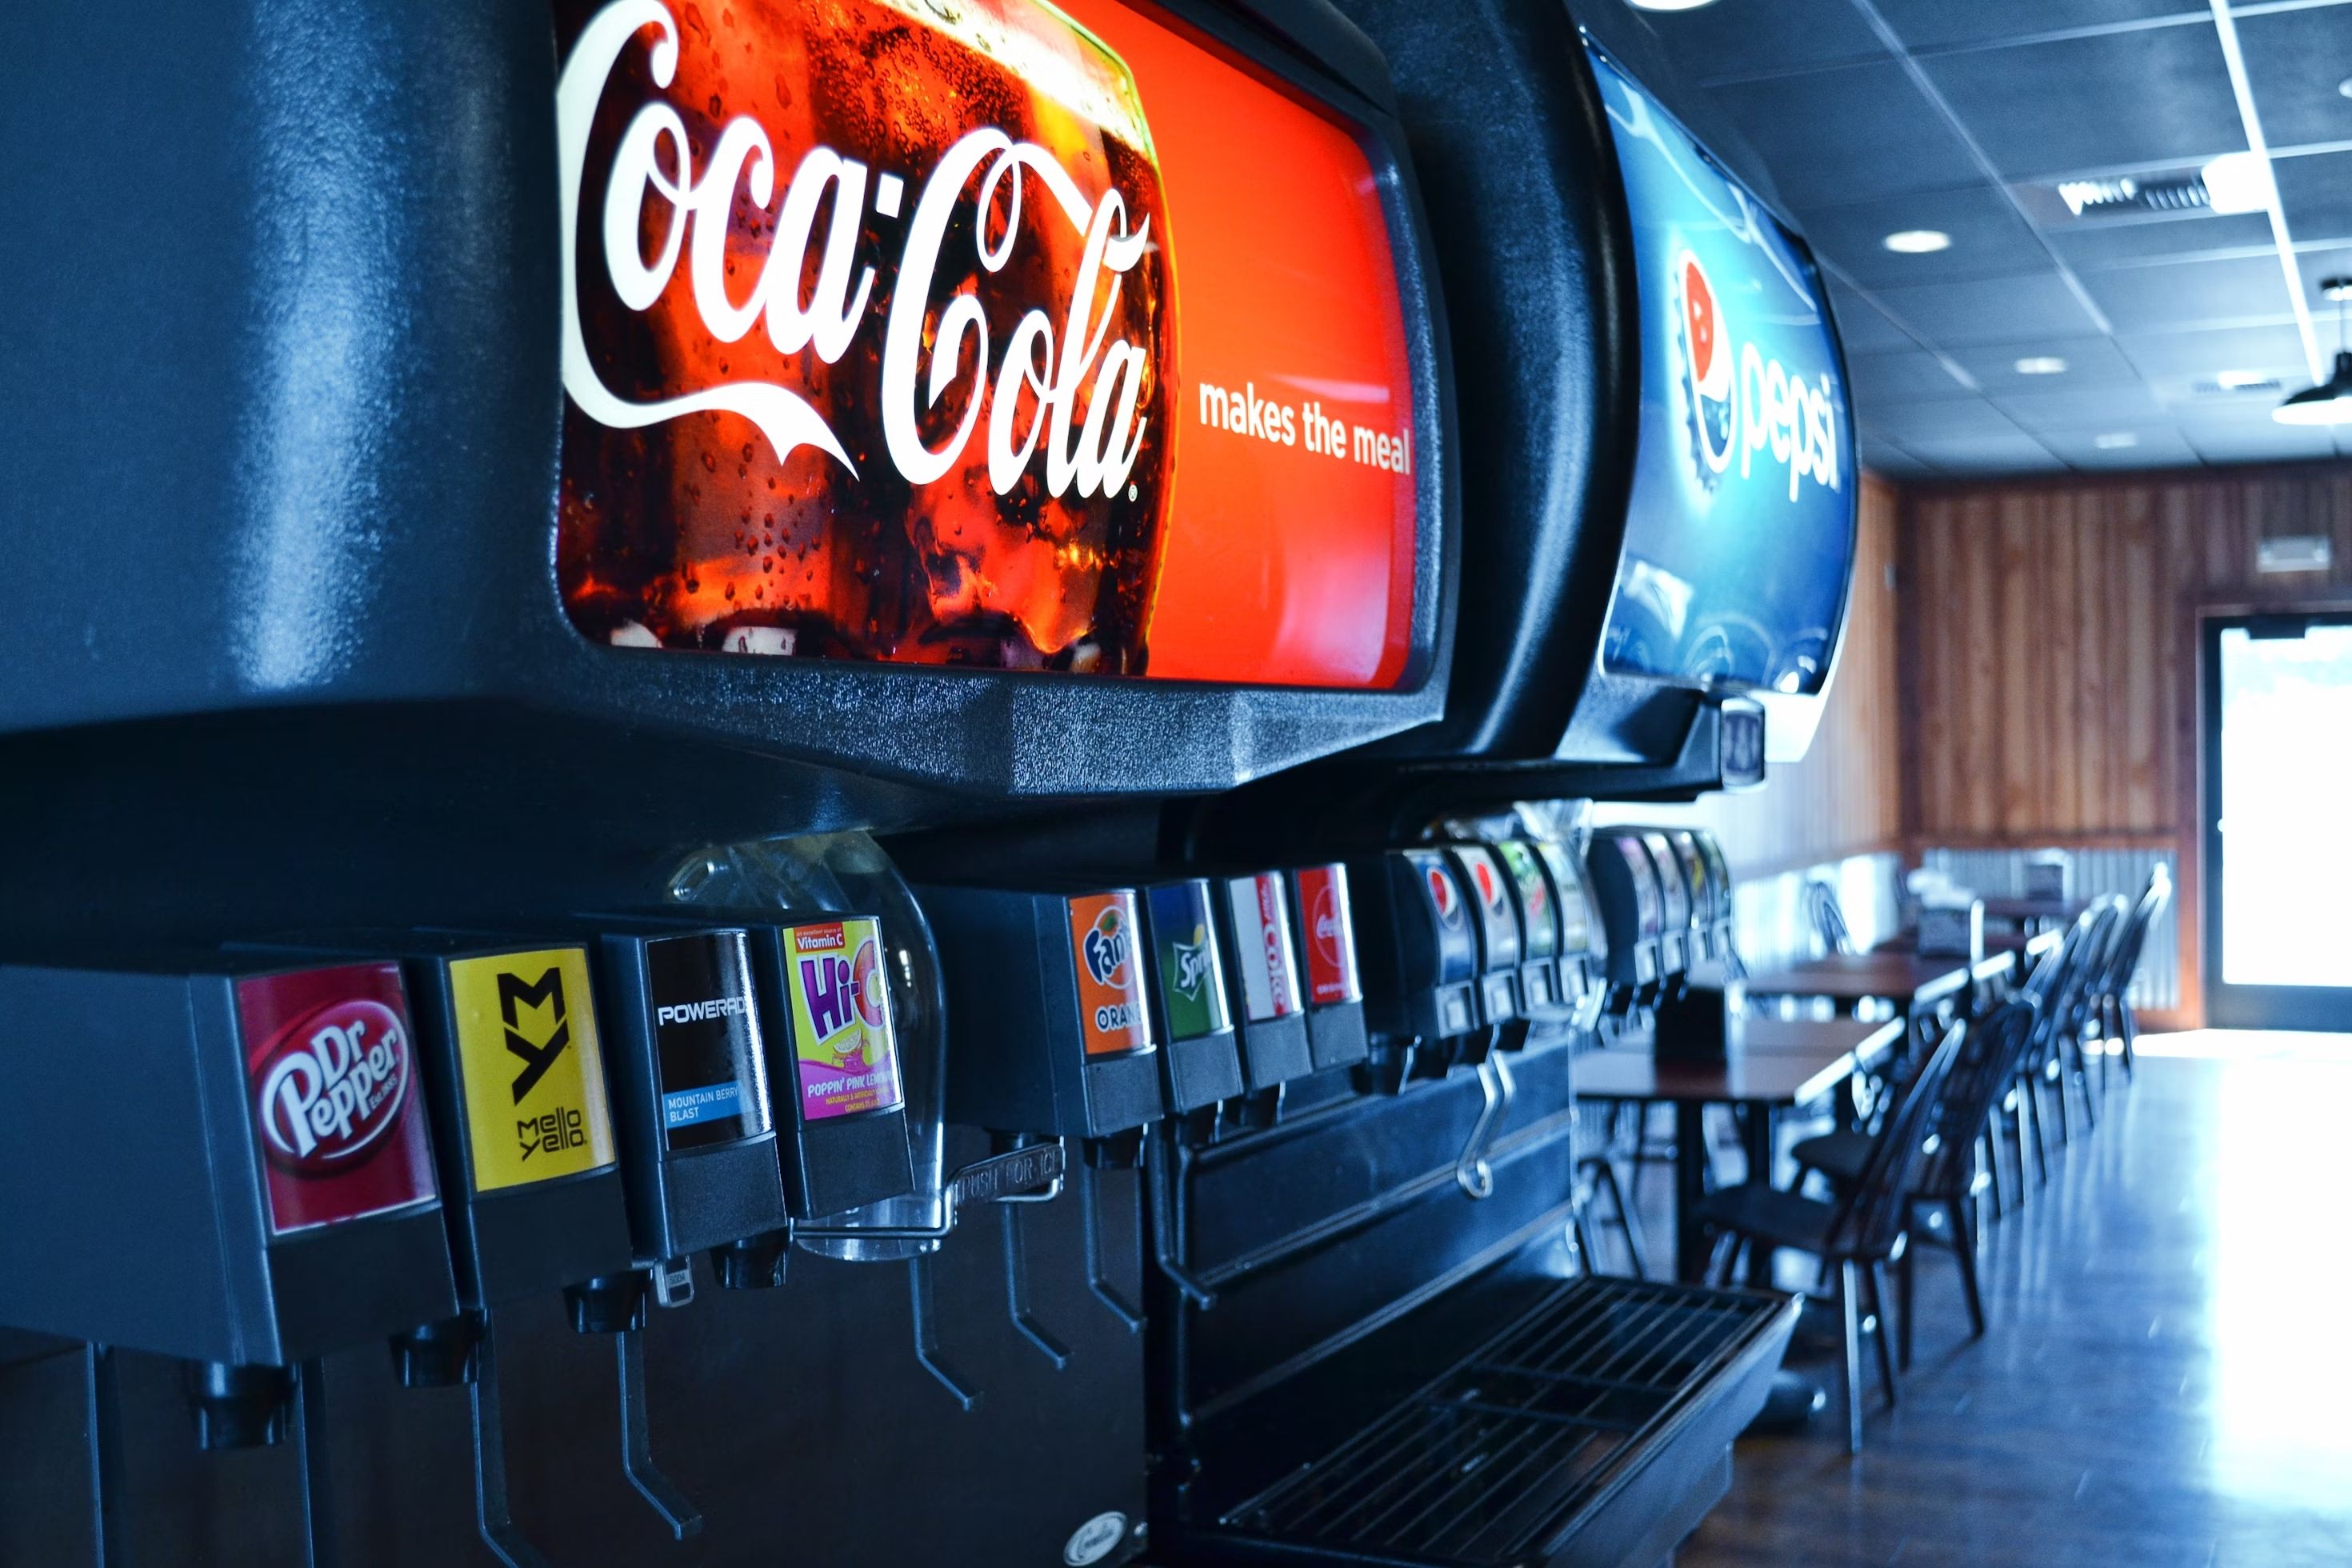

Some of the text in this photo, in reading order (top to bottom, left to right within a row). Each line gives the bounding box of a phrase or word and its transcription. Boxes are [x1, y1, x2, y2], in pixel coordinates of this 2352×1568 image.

[556, 0, 1150, 499] Coca-Cola
[1198, 381, 1411, 475] makes the meal
[1740, 342, 1840, 503] pepsi
[797, 933, 843, 950] Vitamin C
[1083, 920, 1132, 986] Fan
[658, 996, 750, 1026] POWERAD
[797, 935, 885, 1046] Hi-C
[309, 1019, 366, 1088] Dr
[807, 1077, 845, 1098] POPPIN'
[846, 1075, 866, 1090] PINK
[262, 1028, 398, 1158] Pepper
[668, 1087, 738, 1110] MOUNTAIN BERRY
[670, 1106, 699, 1122] BLAST
[962, 1167, 998, 1201] PUSH
